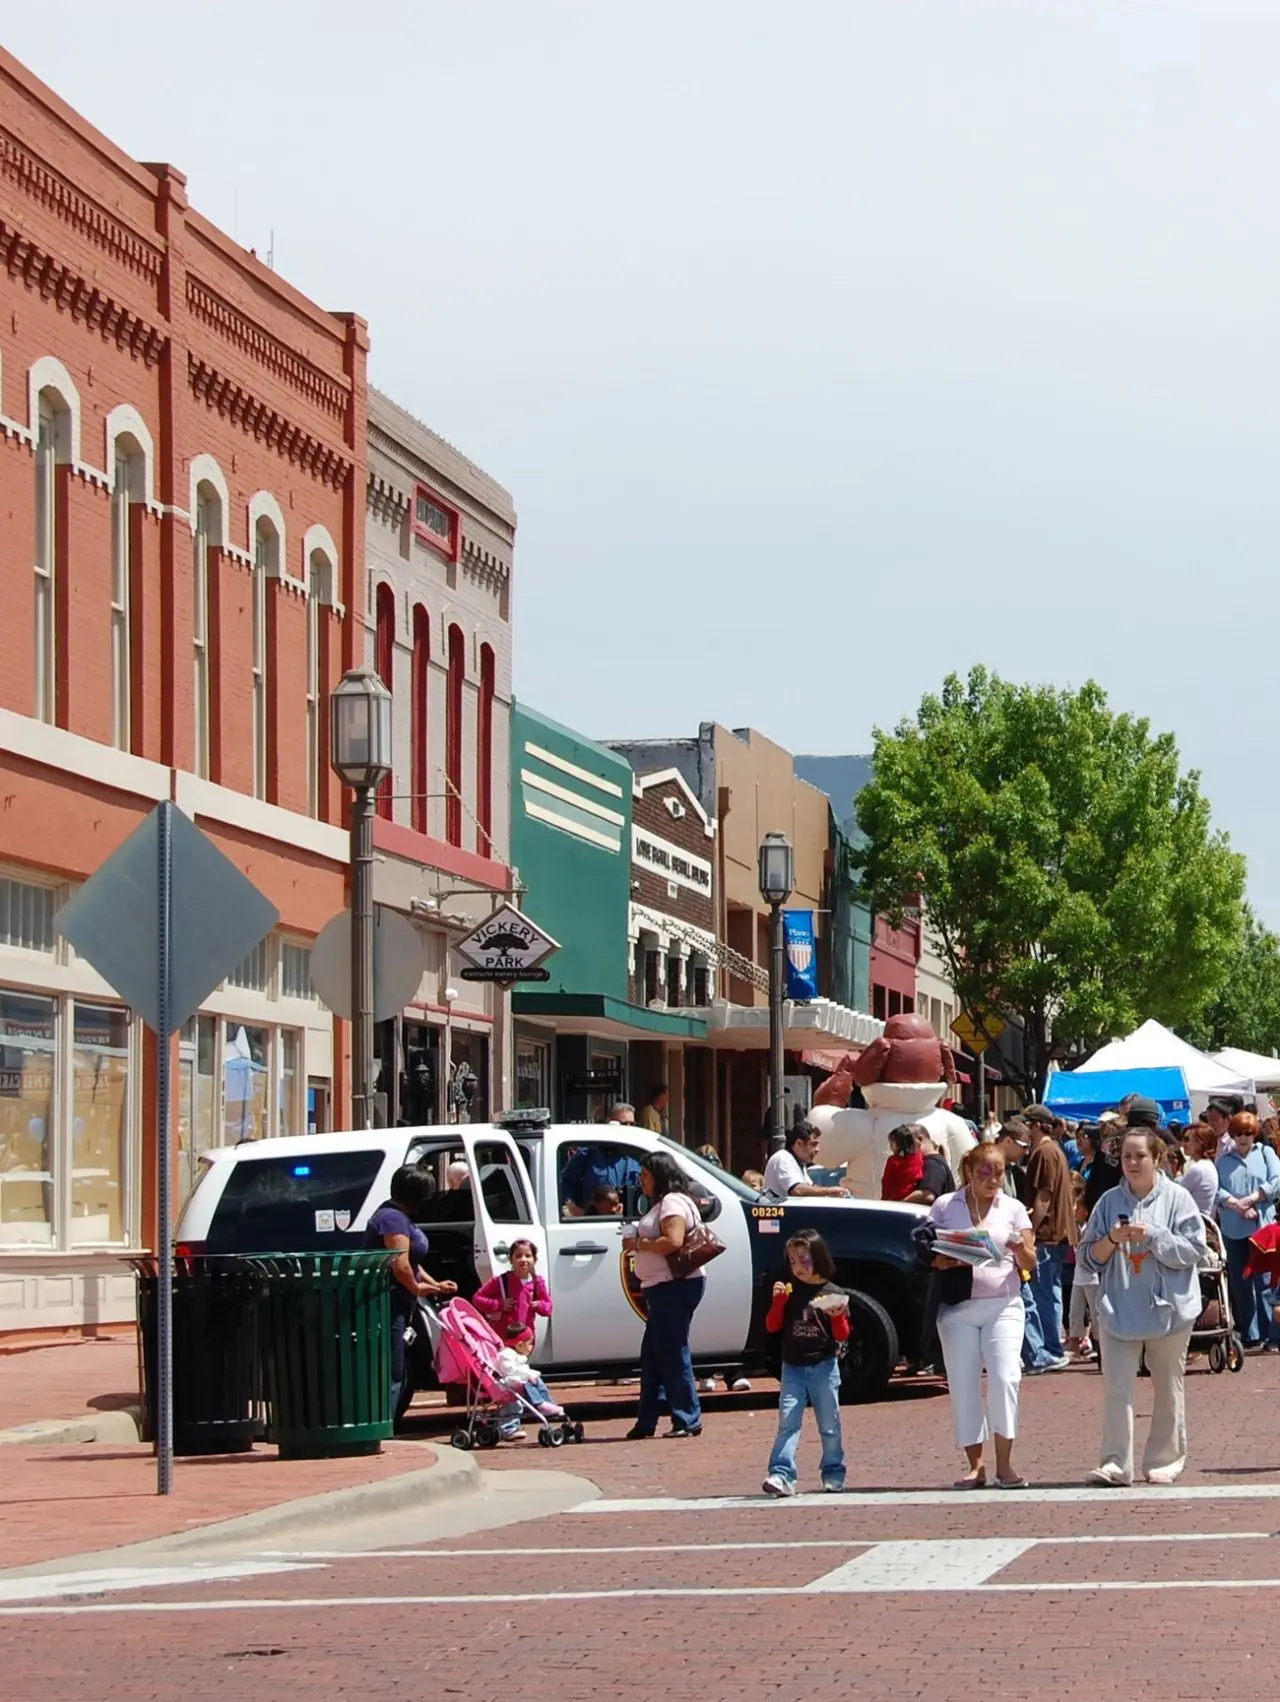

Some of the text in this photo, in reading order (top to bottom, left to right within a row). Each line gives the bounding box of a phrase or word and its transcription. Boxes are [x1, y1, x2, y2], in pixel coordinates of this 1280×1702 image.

[471, 921, 540, 944] VICKERY
[485, 957, 524, 968] PARK
[751, 1207, 785, 1217] 08234
